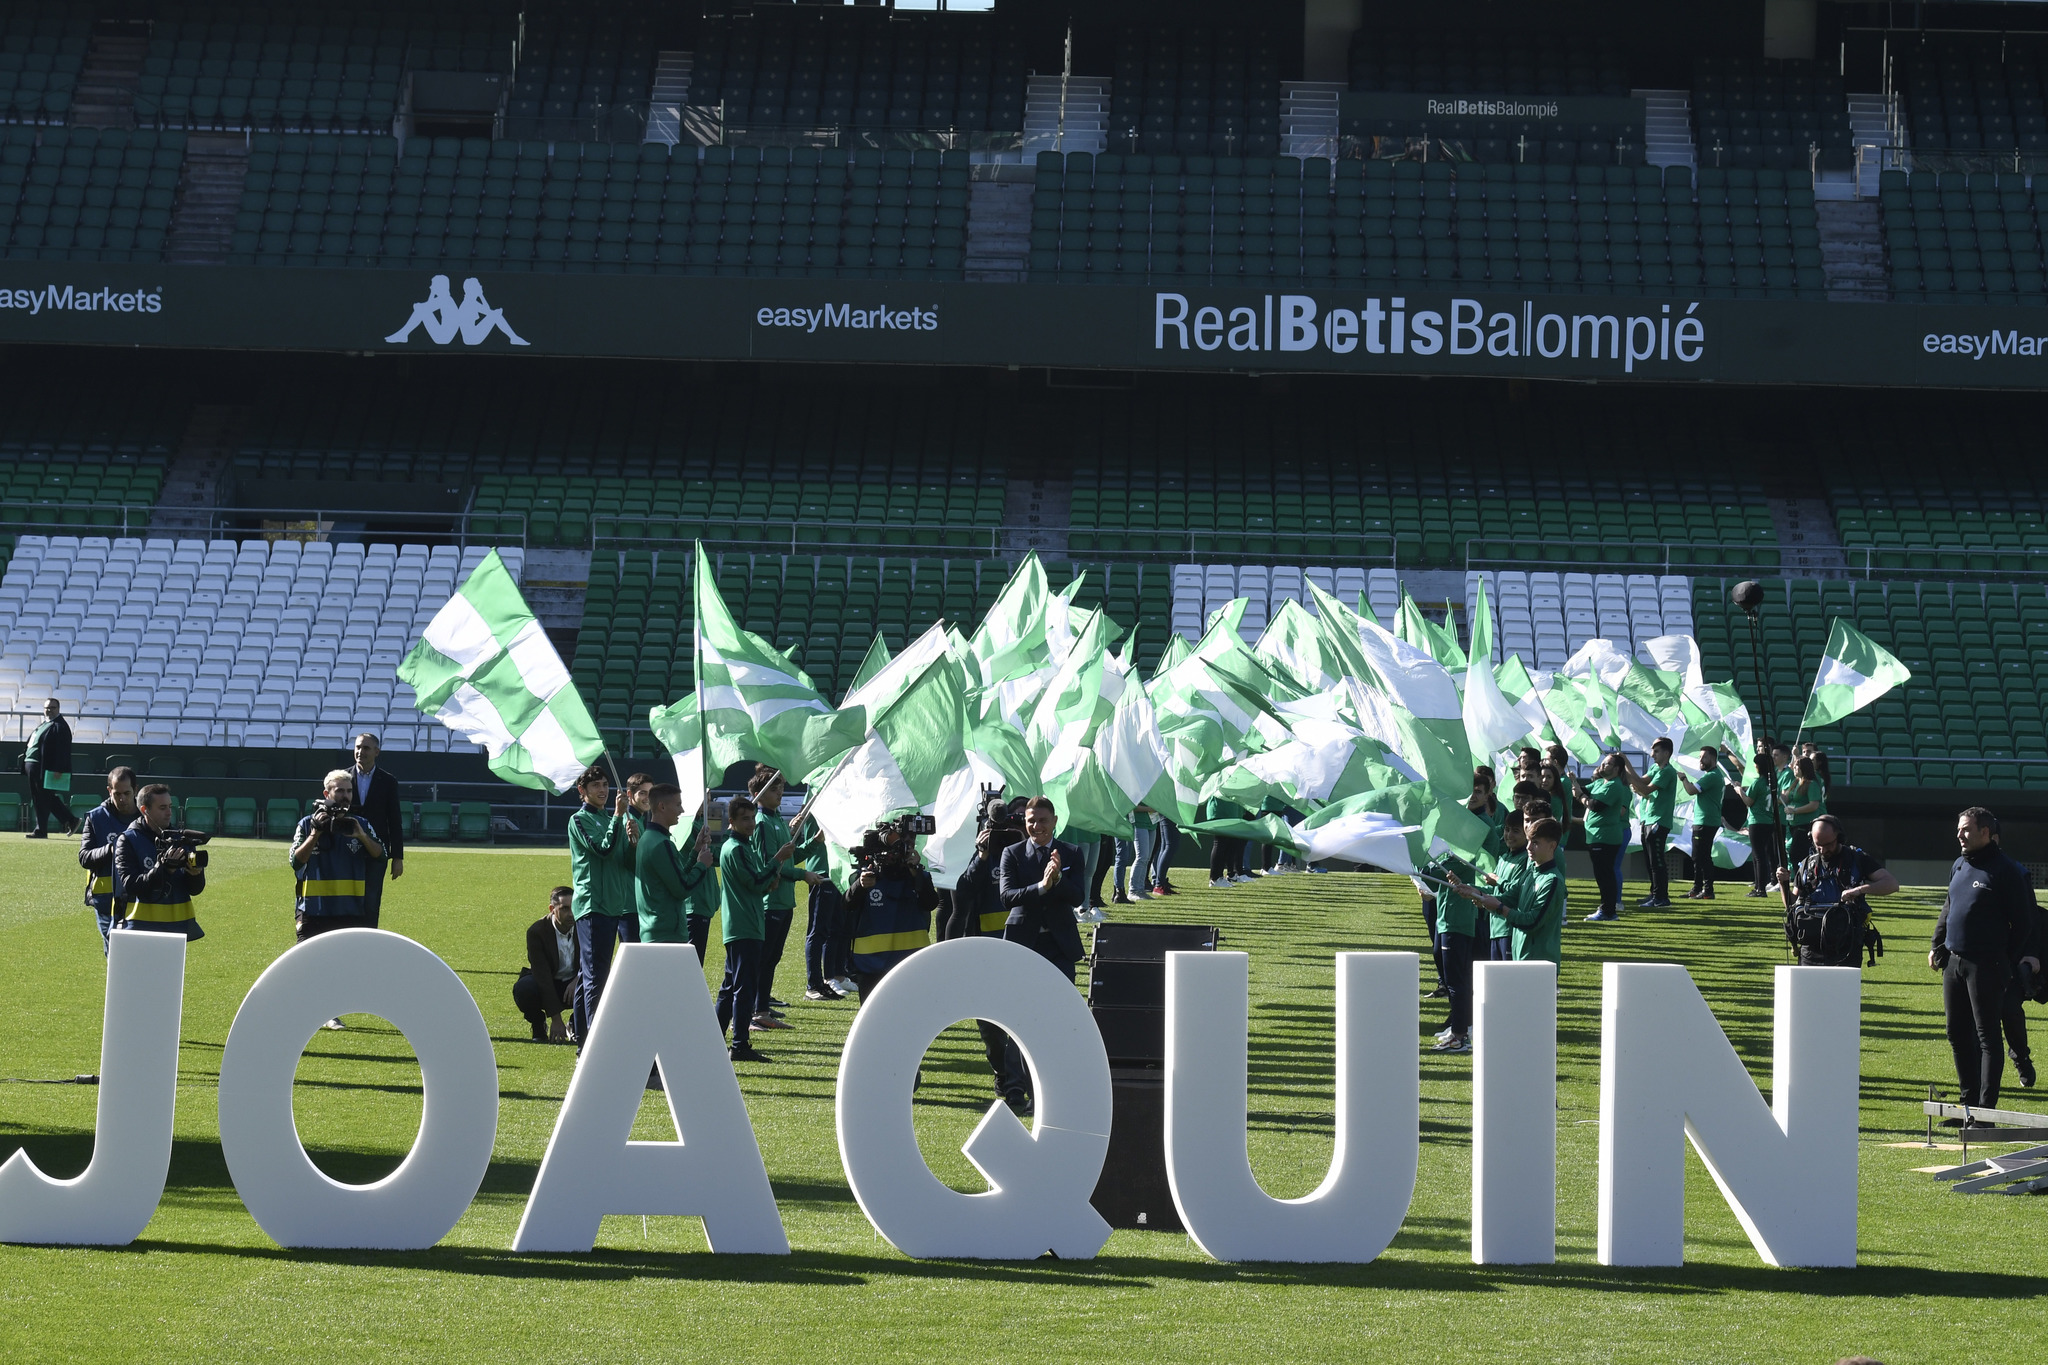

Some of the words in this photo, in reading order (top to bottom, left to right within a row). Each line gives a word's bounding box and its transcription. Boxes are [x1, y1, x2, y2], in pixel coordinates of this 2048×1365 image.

[1427, 99, 1559, 120] RealBetisBalompié
[757, 303, 939, 333] easyMarkets
[1155, 292, 1706, 373] RealBetisBalompié
[0, 928, 1860, 1269] JOAQUIN
